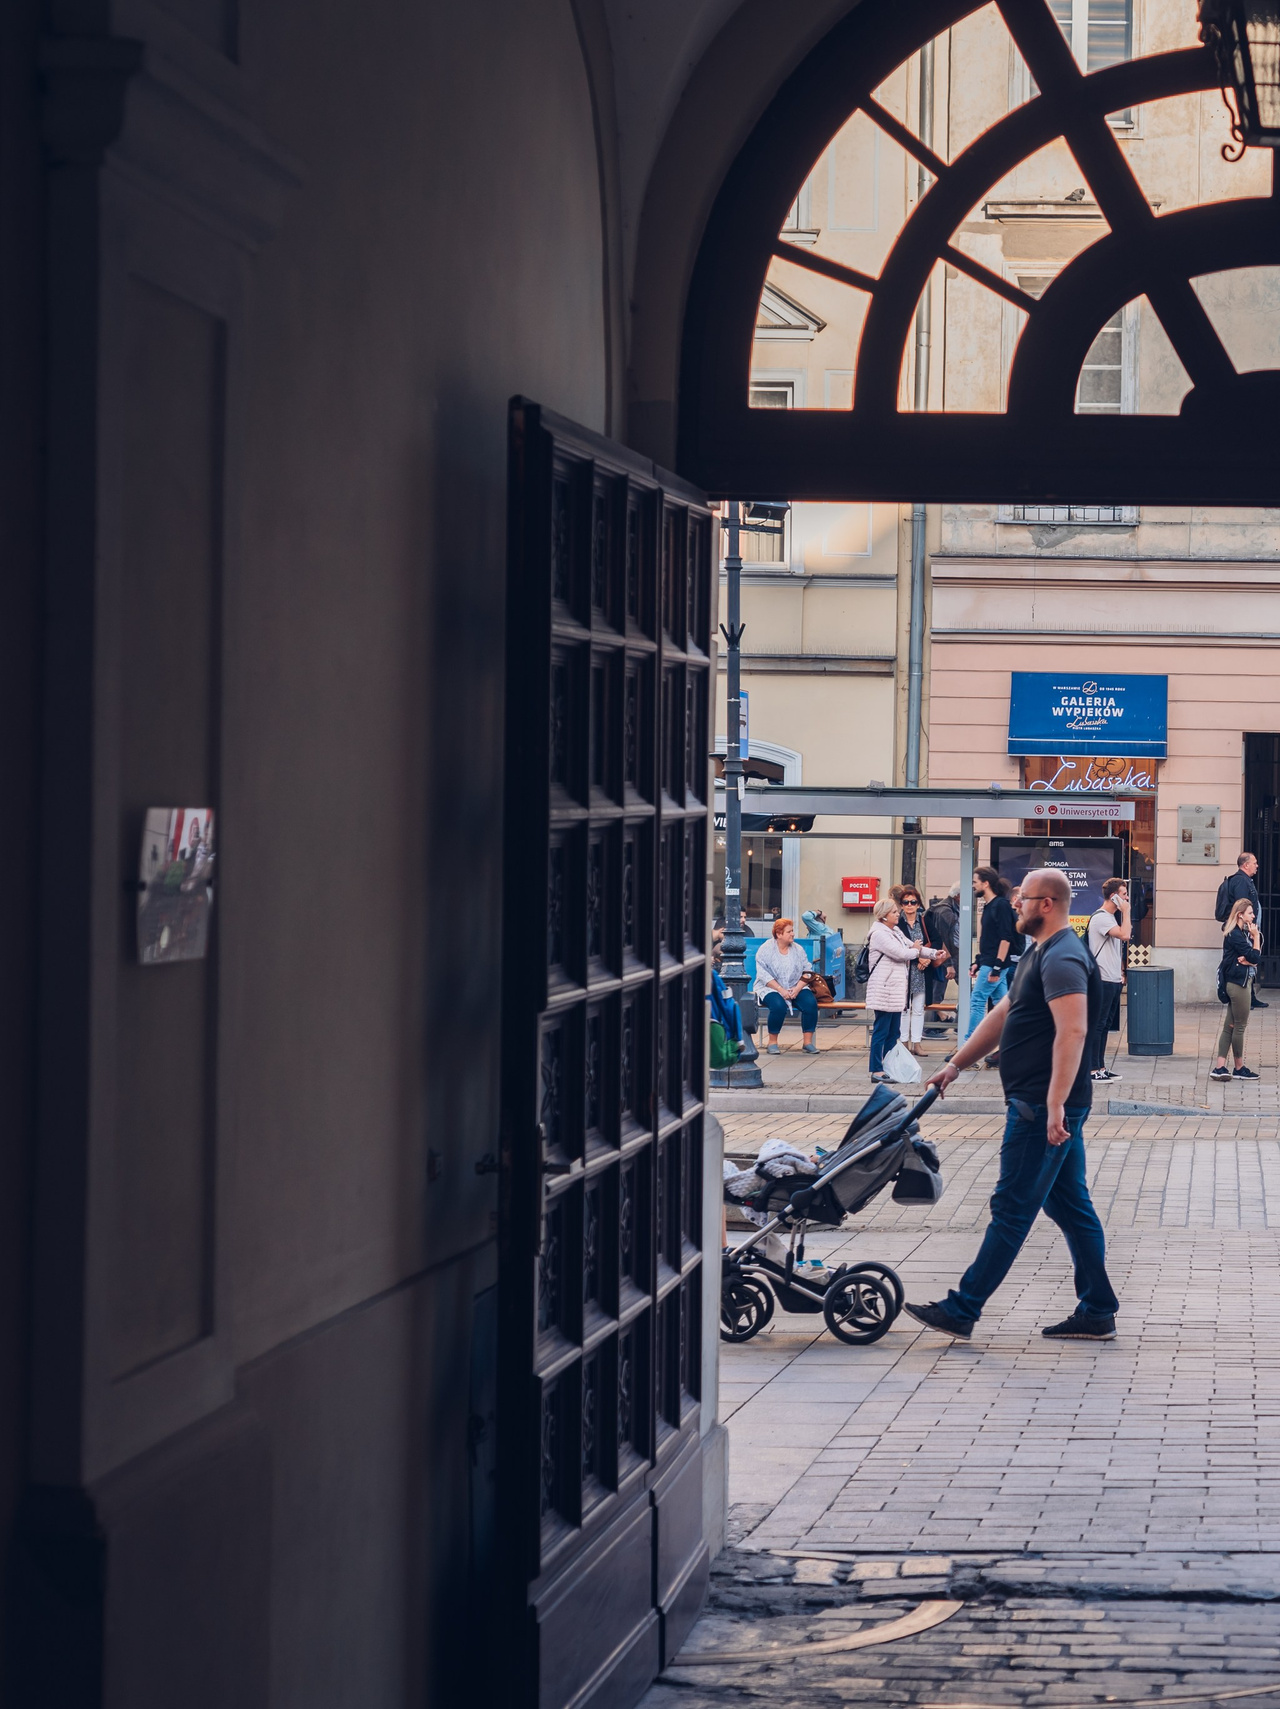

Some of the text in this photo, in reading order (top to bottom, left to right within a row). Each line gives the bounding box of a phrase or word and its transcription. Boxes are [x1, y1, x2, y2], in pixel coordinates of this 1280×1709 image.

[1061, 696, 1116, 706] GALERIA
[1052, 704, 1124, 717] WYPIEKÓW
[1060, 808, 1119, 818] Uniwersytet 02
[1068, 871, 1087, 879] STAN
